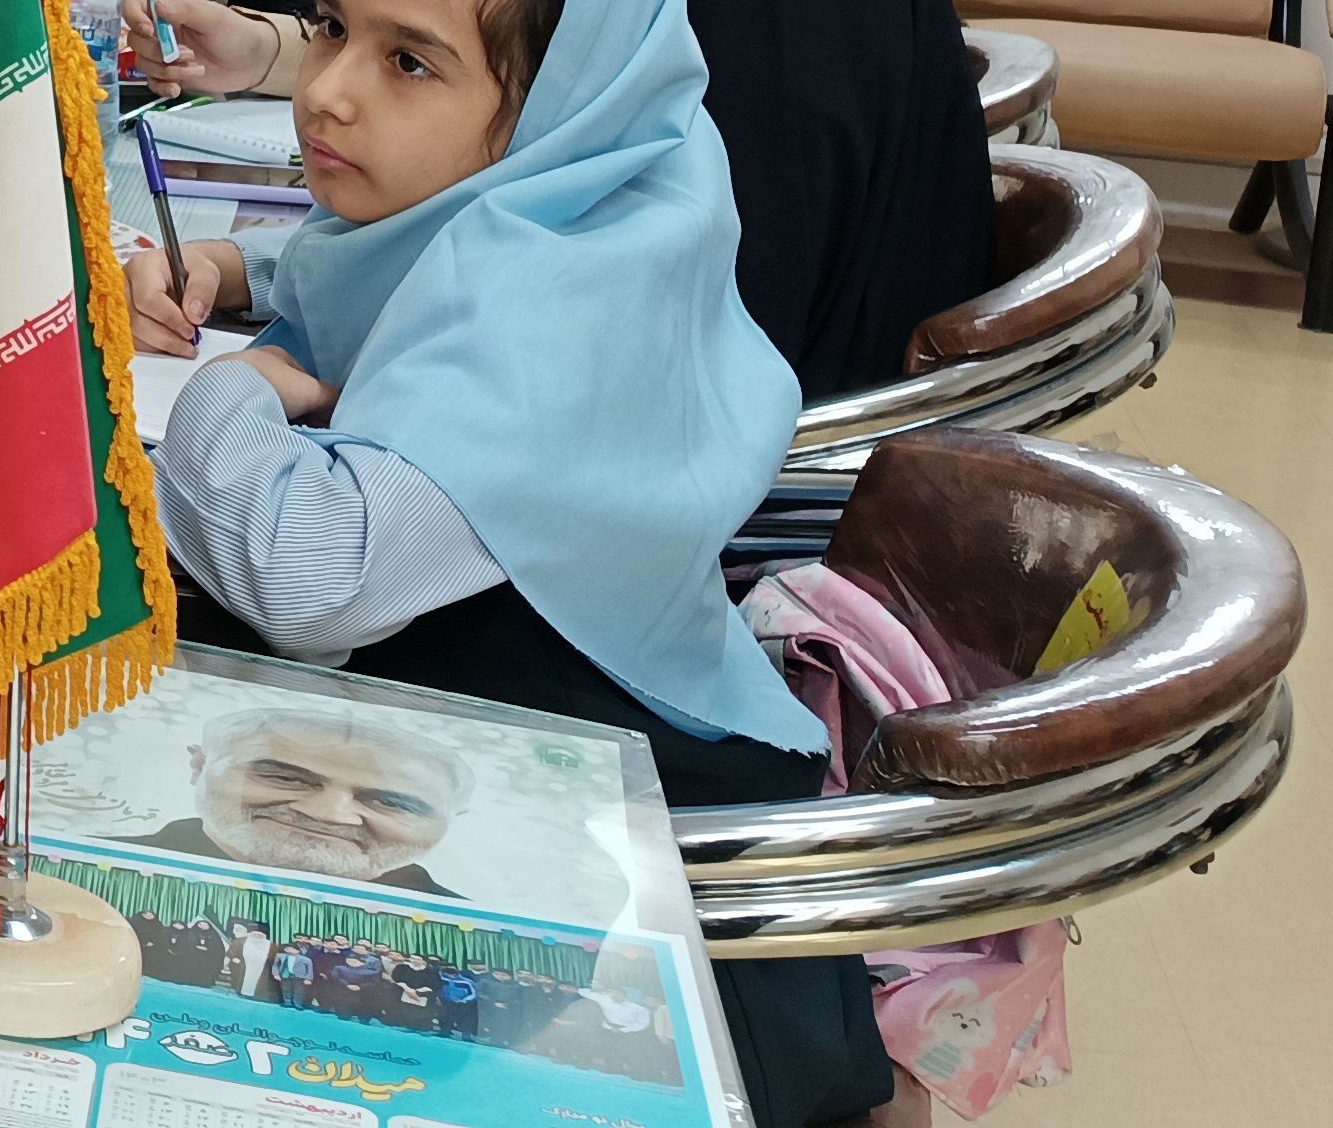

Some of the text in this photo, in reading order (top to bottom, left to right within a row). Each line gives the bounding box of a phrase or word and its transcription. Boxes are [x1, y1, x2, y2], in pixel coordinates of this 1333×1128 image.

[149, 1011, 210, 1030] وطن
[22, 1050, 82, 1066] خرداد
[265, 1094, 362, 1120] اردیبهشت
